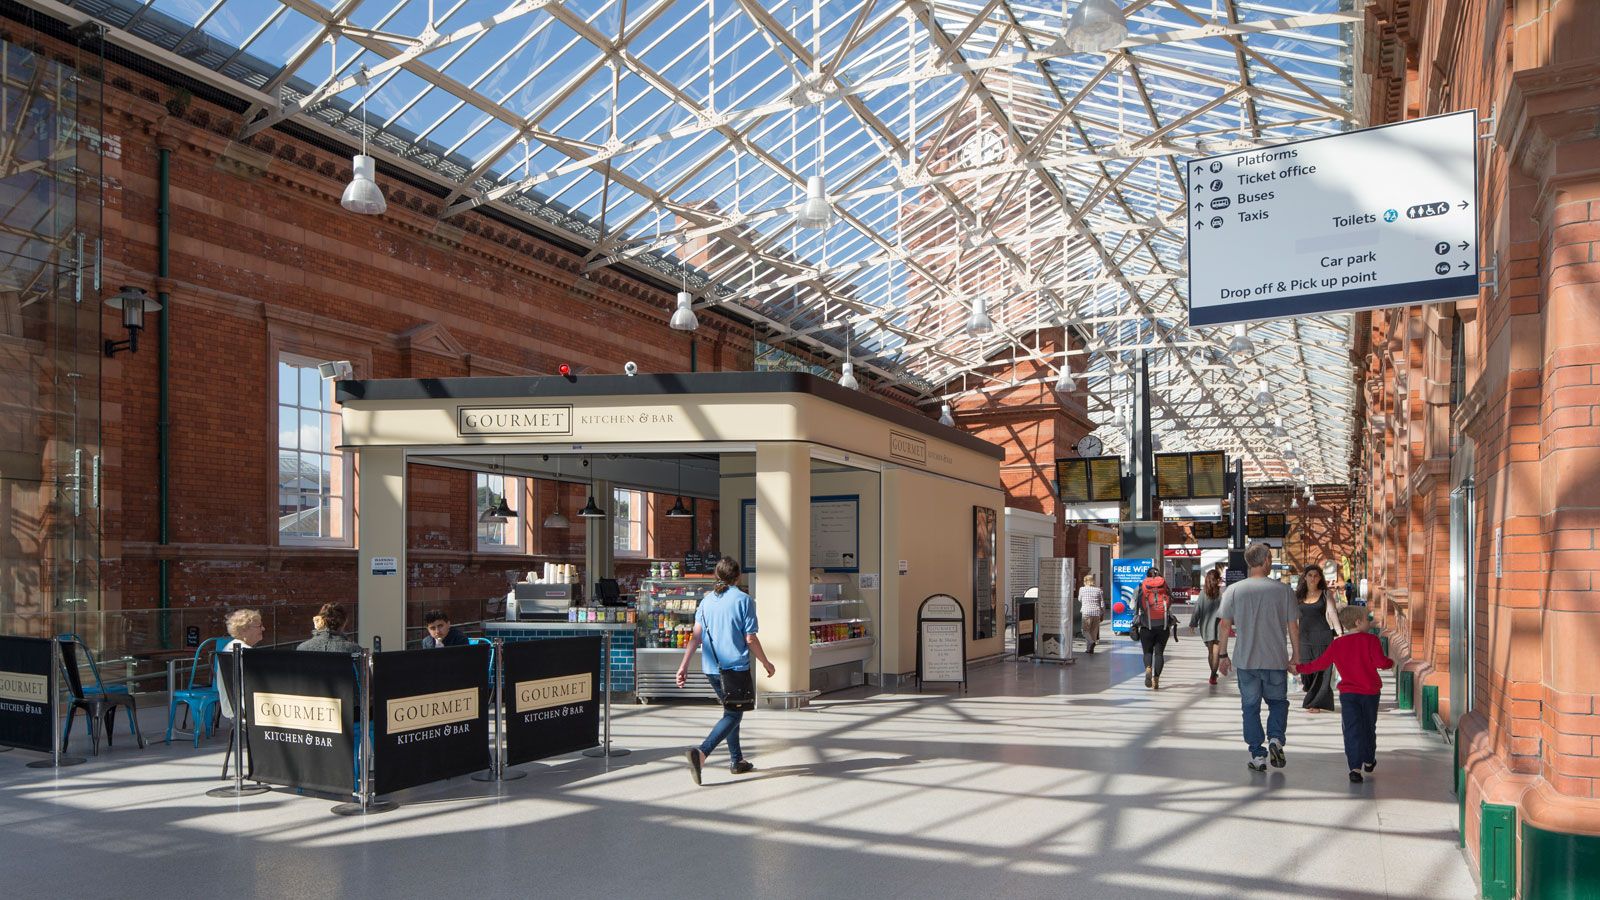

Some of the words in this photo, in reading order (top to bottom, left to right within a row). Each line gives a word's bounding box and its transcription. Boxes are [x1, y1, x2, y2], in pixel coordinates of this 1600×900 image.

[1237, 149, 1298, 167] Platforms
[1237, 171, 1277, 185] Ticket
[1279, 165, 1317, 179] office
[1237, 191, 1275, 204] Buses
[1237, 209, 1269, 222] Taxis
[1332, 213, 1377, 228] Toilets
[1320, 256, 1344, 268] Car
[1347, 251, 1377, 267] park
[1220, 287, 1251, 299] Drop
[1254, 283, 1274, 295] off
[1276, 281, 1287, 292] &
[1290, 278, 1318, 291] Pick
[1321, 277, 1338, 288] up
[1341, 271, 1378, 287] point
[465, 413, 564, 428] GOURMET
[581, 415, 634, 424] KITCHEN
[639, 412, 649, 424] &
[652, 414, 674, 423] BAR
[892, 438, 924, 458] GOURMET
[1113, 565, 1132, 573] FREE
[1133, 565, 1150, 573] WiF
[521, 681, 586, 702] GOURMET
[31, 706, 42, 714] BAR
[260, 702, 335, 722] GOURMET
[394, 697, 472, 722] GOURMET
[524, 709, 560, 723] KITCHEN
[562, 706, 569, 716] &
[569, 705, 584, 715] BAR
[264, 730, 303, 744] KITCHEN
[305, 733, 314, 746] &
[315, 736, 333, 747] BAR
[397, 728, 441, 745] KITCHEN
[443, 725, 452, 736] &
[453, 723, 470, 734] BAR
